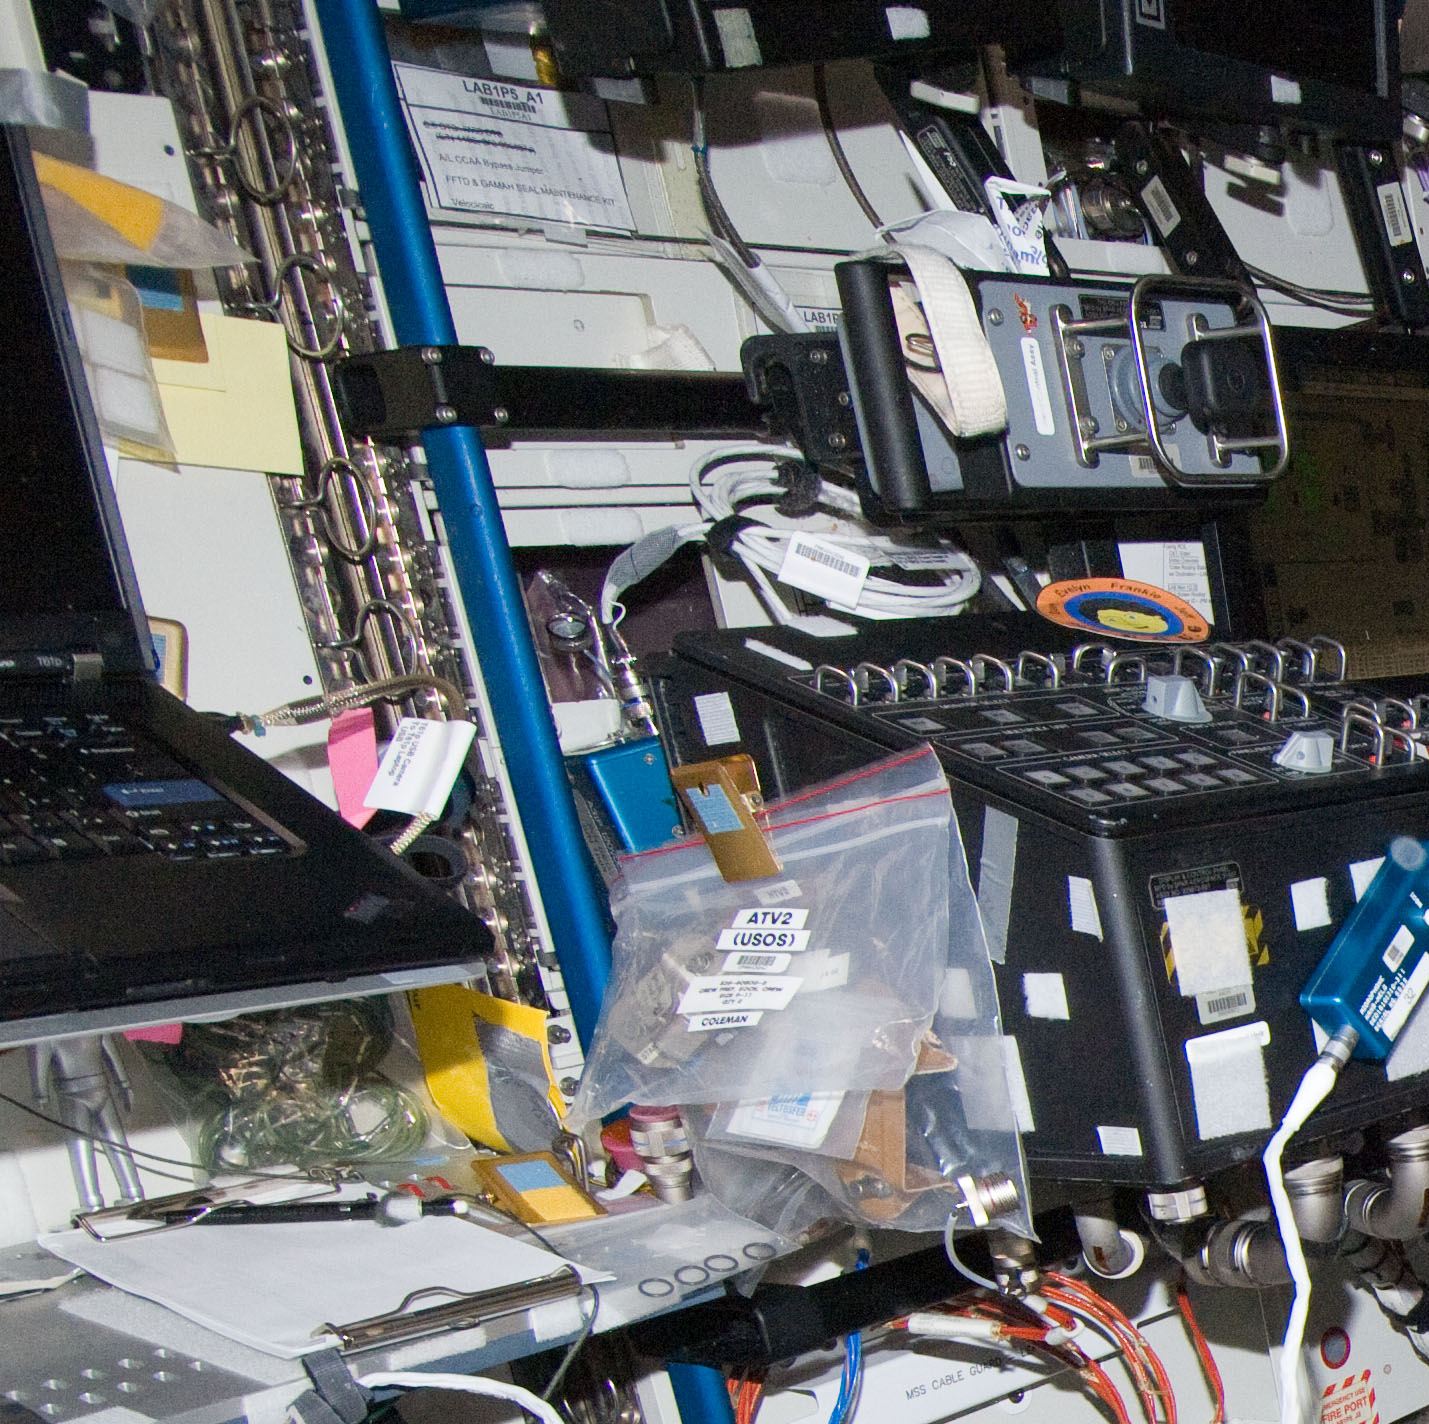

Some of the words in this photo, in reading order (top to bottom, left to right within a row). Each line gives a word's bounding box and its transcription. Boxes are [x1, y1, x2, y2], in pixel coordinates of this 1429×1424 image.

[746, 911, 793, 925] ATV2
[732, 932, 796, 947] (USOS)
[700, 1014, 749, 1028] COLEMAN
[905, 1384, 928, 1401] MSS
[931, 1370, 966, 1391] CABLE
[1321, 1407, 1342, 1424] FIRE
[1344, 1396, 1368, 1415] PORT
